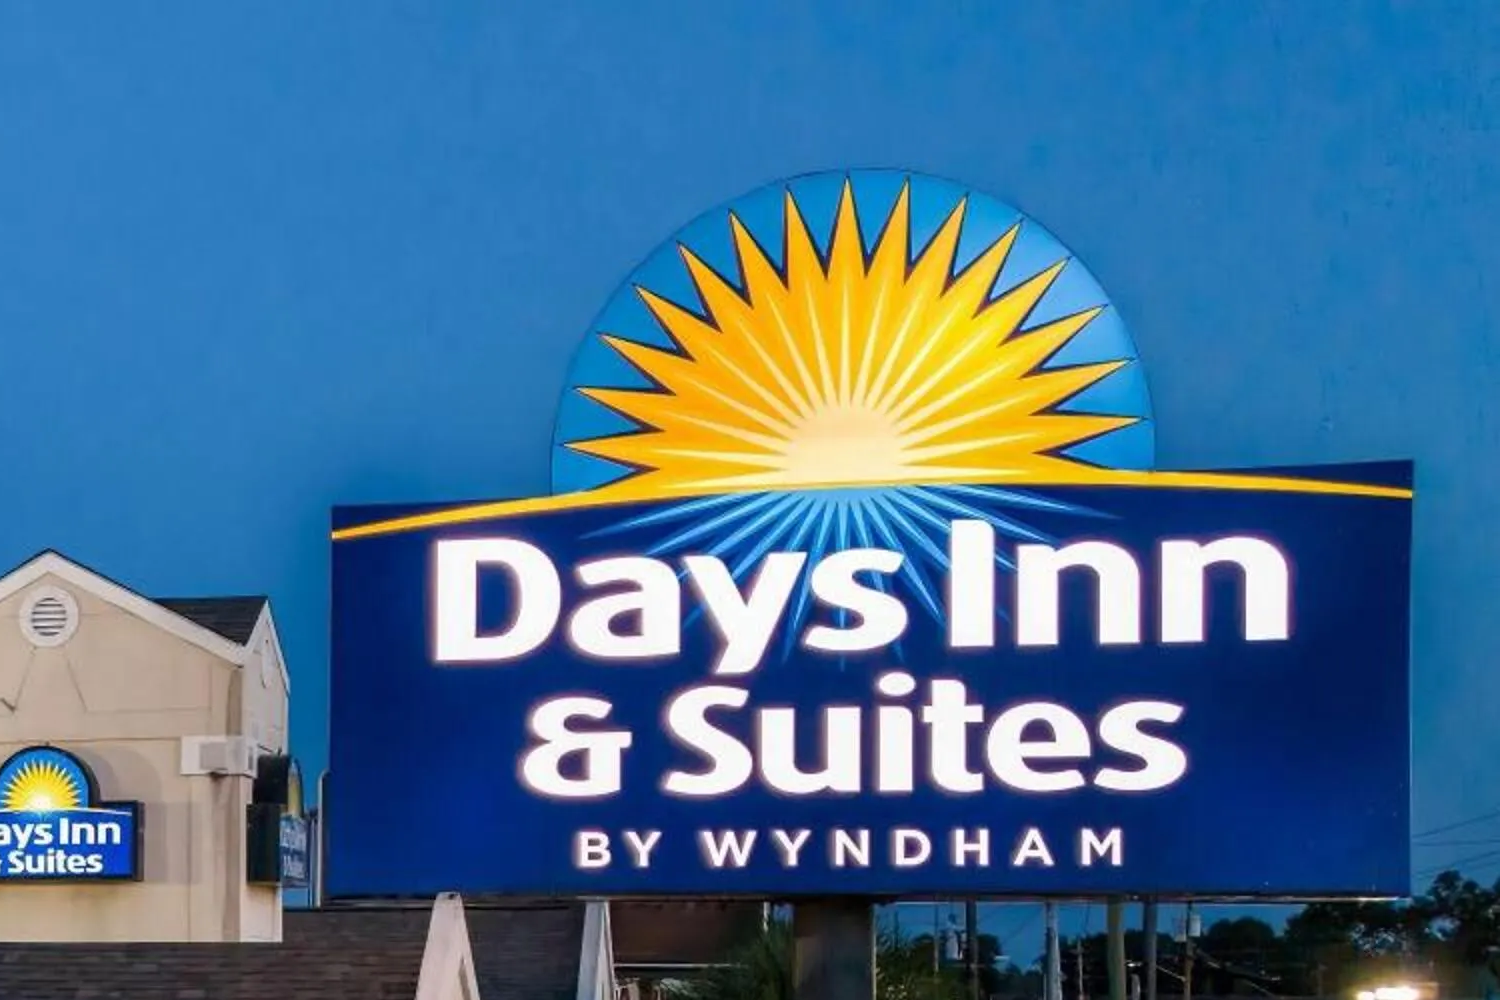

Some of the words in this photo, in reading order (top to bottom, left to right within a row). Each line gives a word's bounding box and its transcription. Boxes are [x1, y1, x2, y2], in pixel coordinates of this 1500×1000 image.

[434, 536, 908, 675] Days
[947, 518, 1291, 648] Inn
[521, 696, 633, 798] &
[663, 671, 1188, 797] Suites
[59, 817, 122, 845] Inn
[577, 830, 662, 868] BY
[701, 827, 1124, 867] WYNDHAM
[7, 848, 104, 874] Suites
